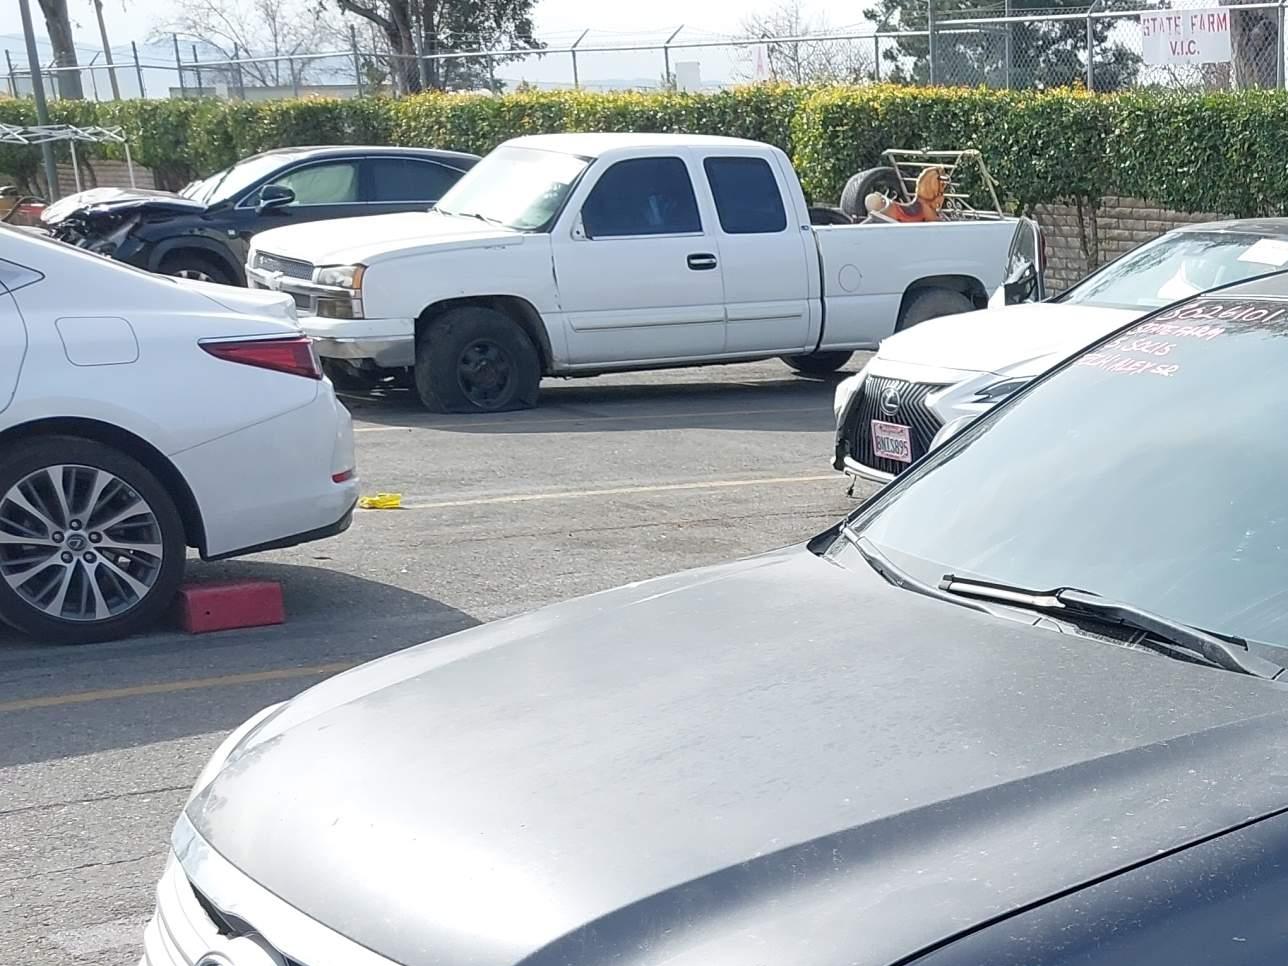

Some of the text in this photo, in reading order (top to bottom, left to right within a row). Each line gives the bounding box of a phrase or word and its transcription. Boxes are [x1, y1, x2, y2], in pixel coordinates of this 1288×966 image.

[1142, 13, 1228, 36] STATE FARM
[1169, 40, 1200, 56] V.I.C.
